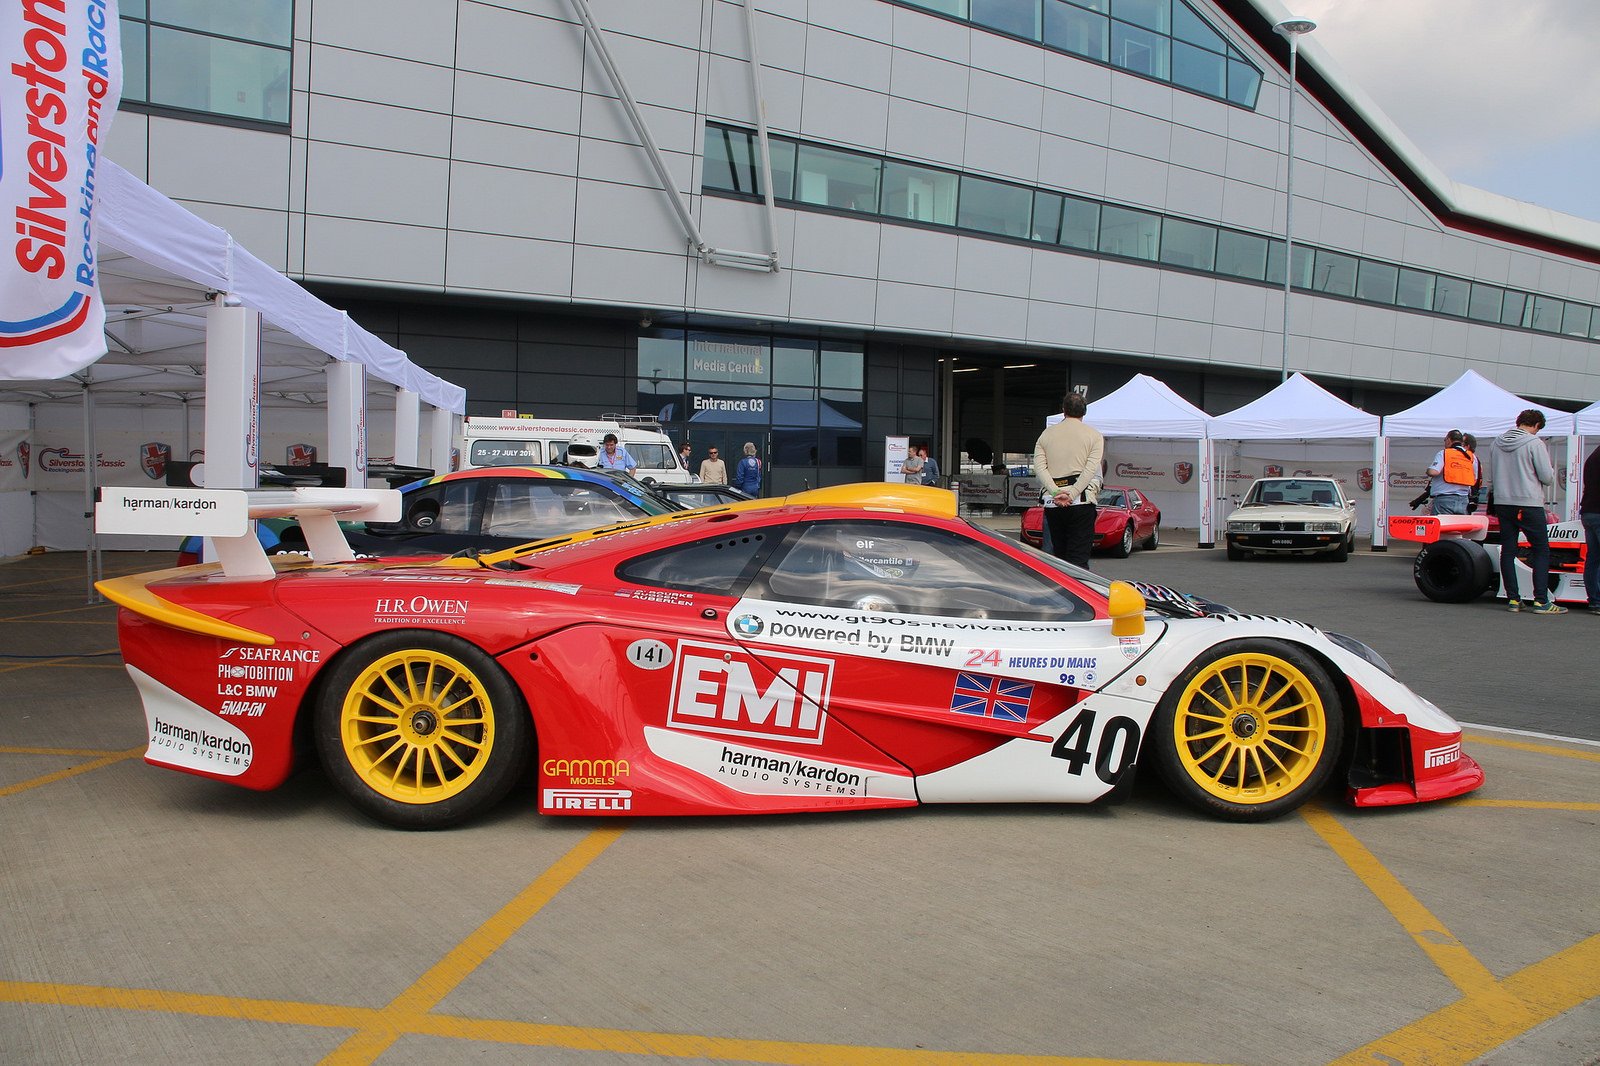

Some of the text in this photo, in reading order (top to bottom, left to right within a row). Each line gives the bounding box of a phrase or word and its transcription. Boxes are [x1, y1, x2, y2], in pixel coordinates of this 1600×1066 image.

[694, 341, 763, 355] International
[693, 359, 764, 374] Media Centre
[693, 396, 764, 412] Entrance 03
[498, 424, 595, 433] www.silverstoneclassic.com
[123, 496, 217, 509] harman/kardon
[1547, 525, 1579, 539] lboro
[410, 595, 469, 614] OWEN
[775, 609, 1066, 632] www.gt90s-revival.com
[769, 621, 954, 657] powered by BMW
[240, 647, 320, 663] SEAFRANCE
[964, 648, 1096, 669] 24 HEURES DU MANS
[1059, 673, 1075, 685] 98
[218, 684, 278, 698] L&C BMW
[677, 654, 825, 731] EMI
[219, 701, 267, 717] SNAP-ON
[155, 717, 251, 756] harman/kardon
[151, 735, 250, 767] AUDIO SYSTEMS
[1051, 708, 1141, 786] 40
[1424, 741, 1461, 769] PIRELLI
[543, 759, 630, 776] GAMMA
[721, 746, 860, 786] harman/kardon
[570, 777, 615, 785] MODELS
[718, 765, 857, 796] AUDIO SYSTEMS
[543, 788, 633, 810] PIRELLI
